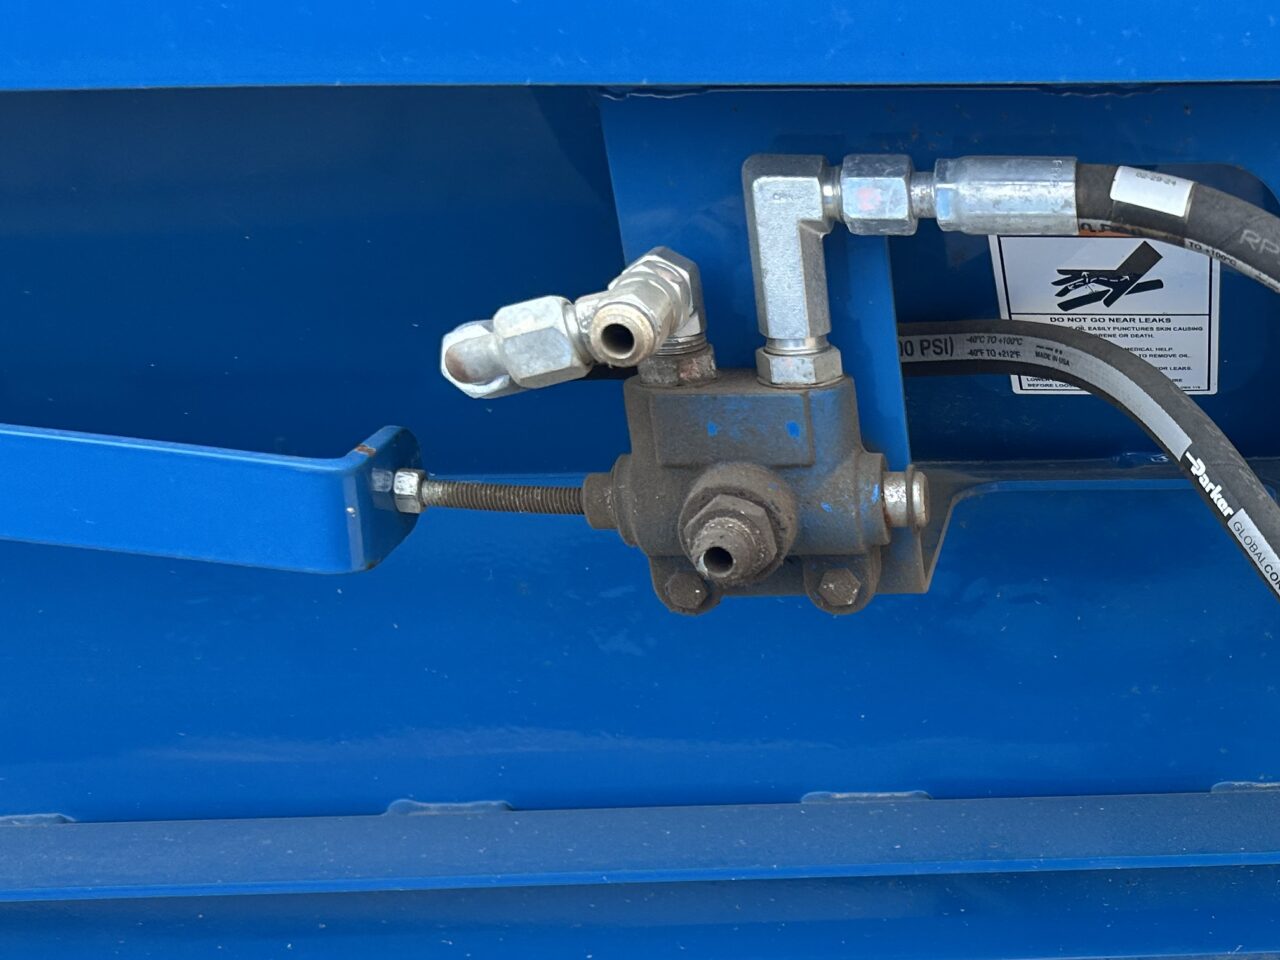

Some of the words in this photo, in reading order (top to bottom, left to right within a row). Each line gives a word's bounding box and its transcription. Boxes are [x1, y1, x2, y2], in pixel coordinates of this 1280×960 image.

[920, 336, 954, 356] PSI)
[987, 336, 997, 344] TO
[1035, 351, 1051, 360] MADE
[1059, 357, 1070, 366] USA
[1186, 451, 1234, 516] Parker
